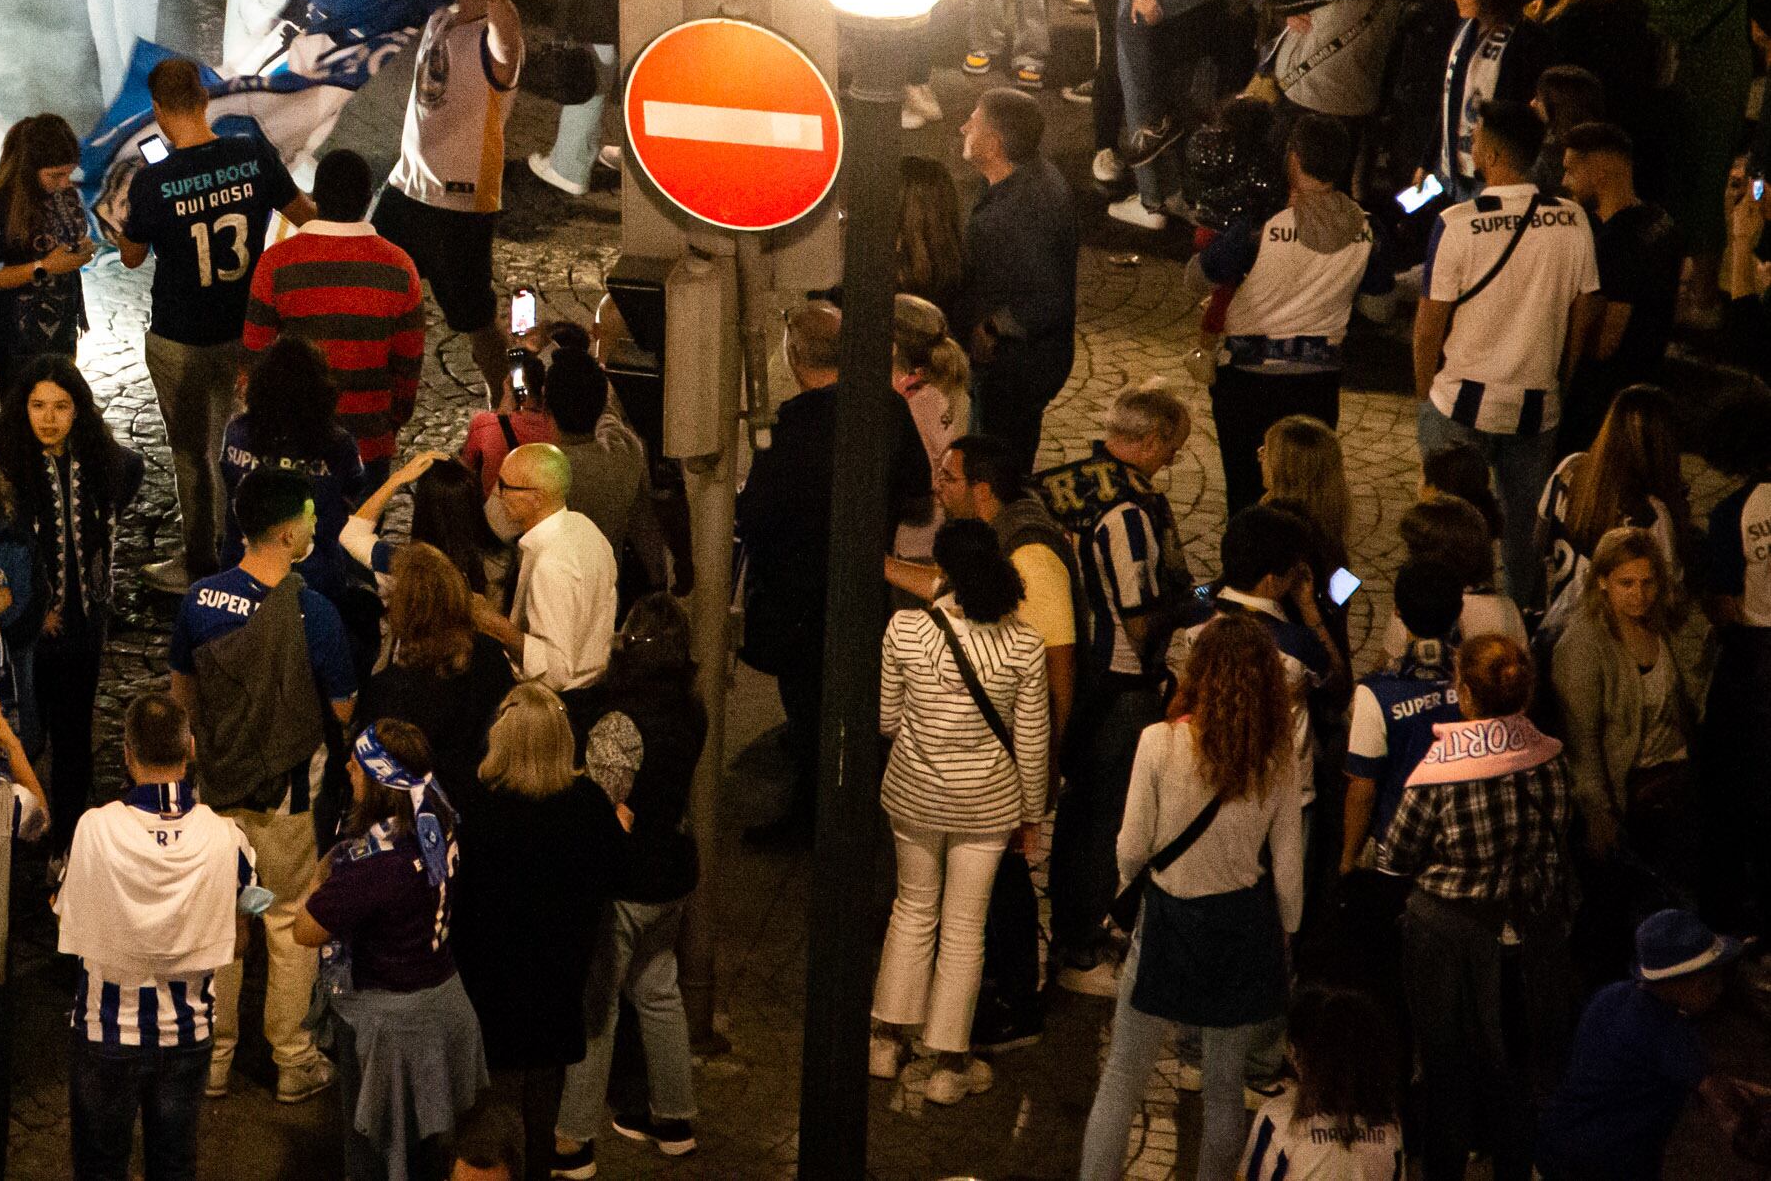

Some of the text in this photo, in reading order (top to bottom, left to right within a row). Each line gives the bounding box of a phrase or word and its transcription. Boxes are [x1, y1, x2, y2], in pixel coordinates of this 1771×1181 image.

[161, 159, 262, 200] SUPER BOCK
[175, 182, 255, 217] RUI ROSA
[189, 213, 251, 289] 13
[196, 588, 251, 618] SUPER
[1391, 692, 1442, 721] SUPER
